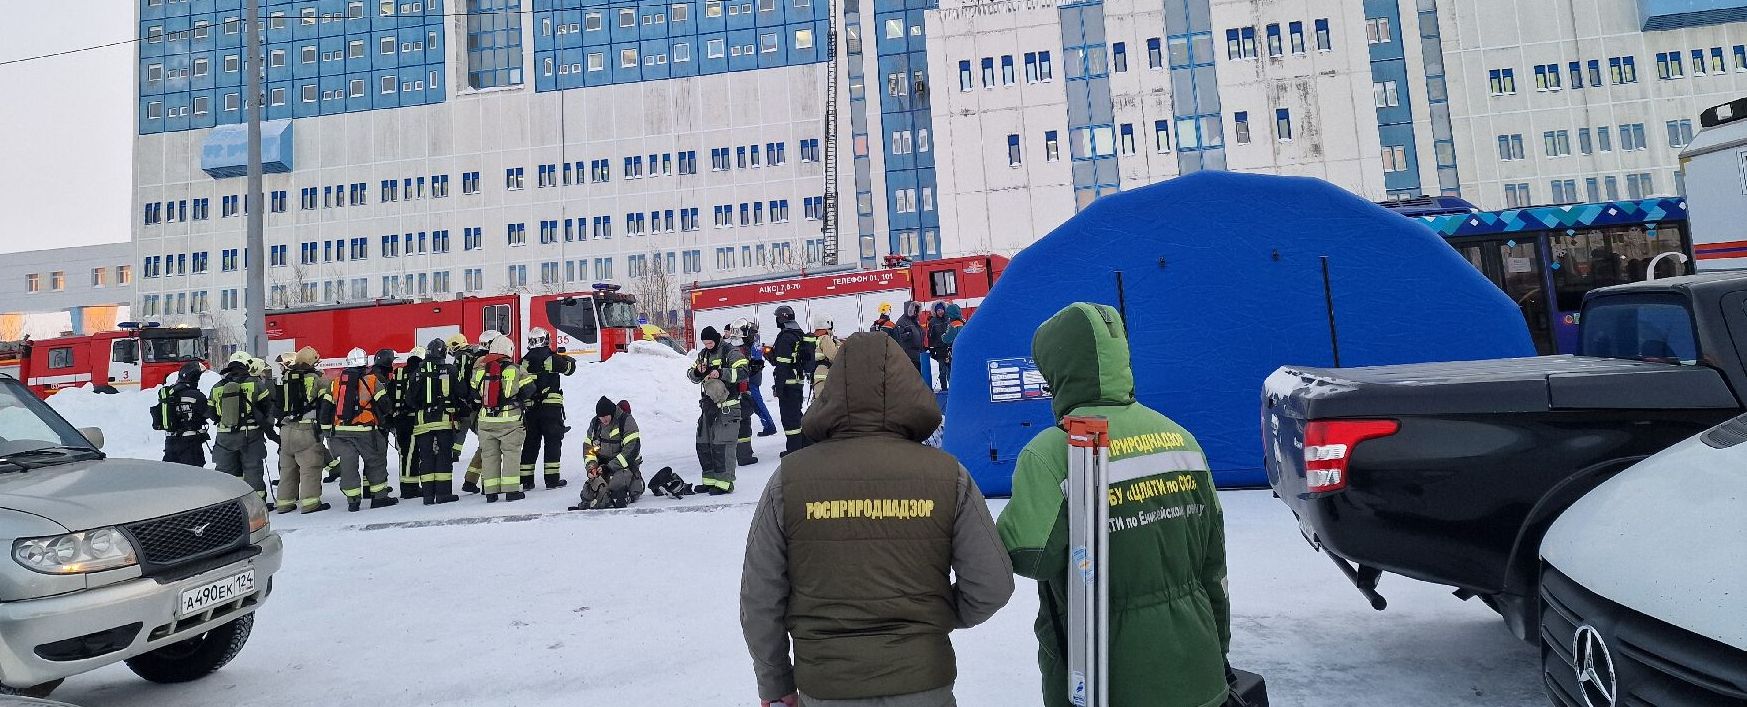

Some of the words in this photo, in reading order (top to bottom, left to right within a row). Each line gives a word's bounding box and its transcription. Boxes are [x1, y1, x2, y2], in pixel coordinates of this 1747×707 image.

[833, 276, 868, 285] ТЕЛЕФОН
[557, 336, 570, 344] 35
[123, 371, 129, 379] 3
[1166, 480, 1179, 493] по
[805, 499, 934, 519] РОСПРИРОДНАДЗОР
[1108, 516, 1125, 533] ТИ
[1126, 515, 1138, 528] по
[186, 583, 233, 610] А490ЕК
[235, 572, 254, 588] 124
